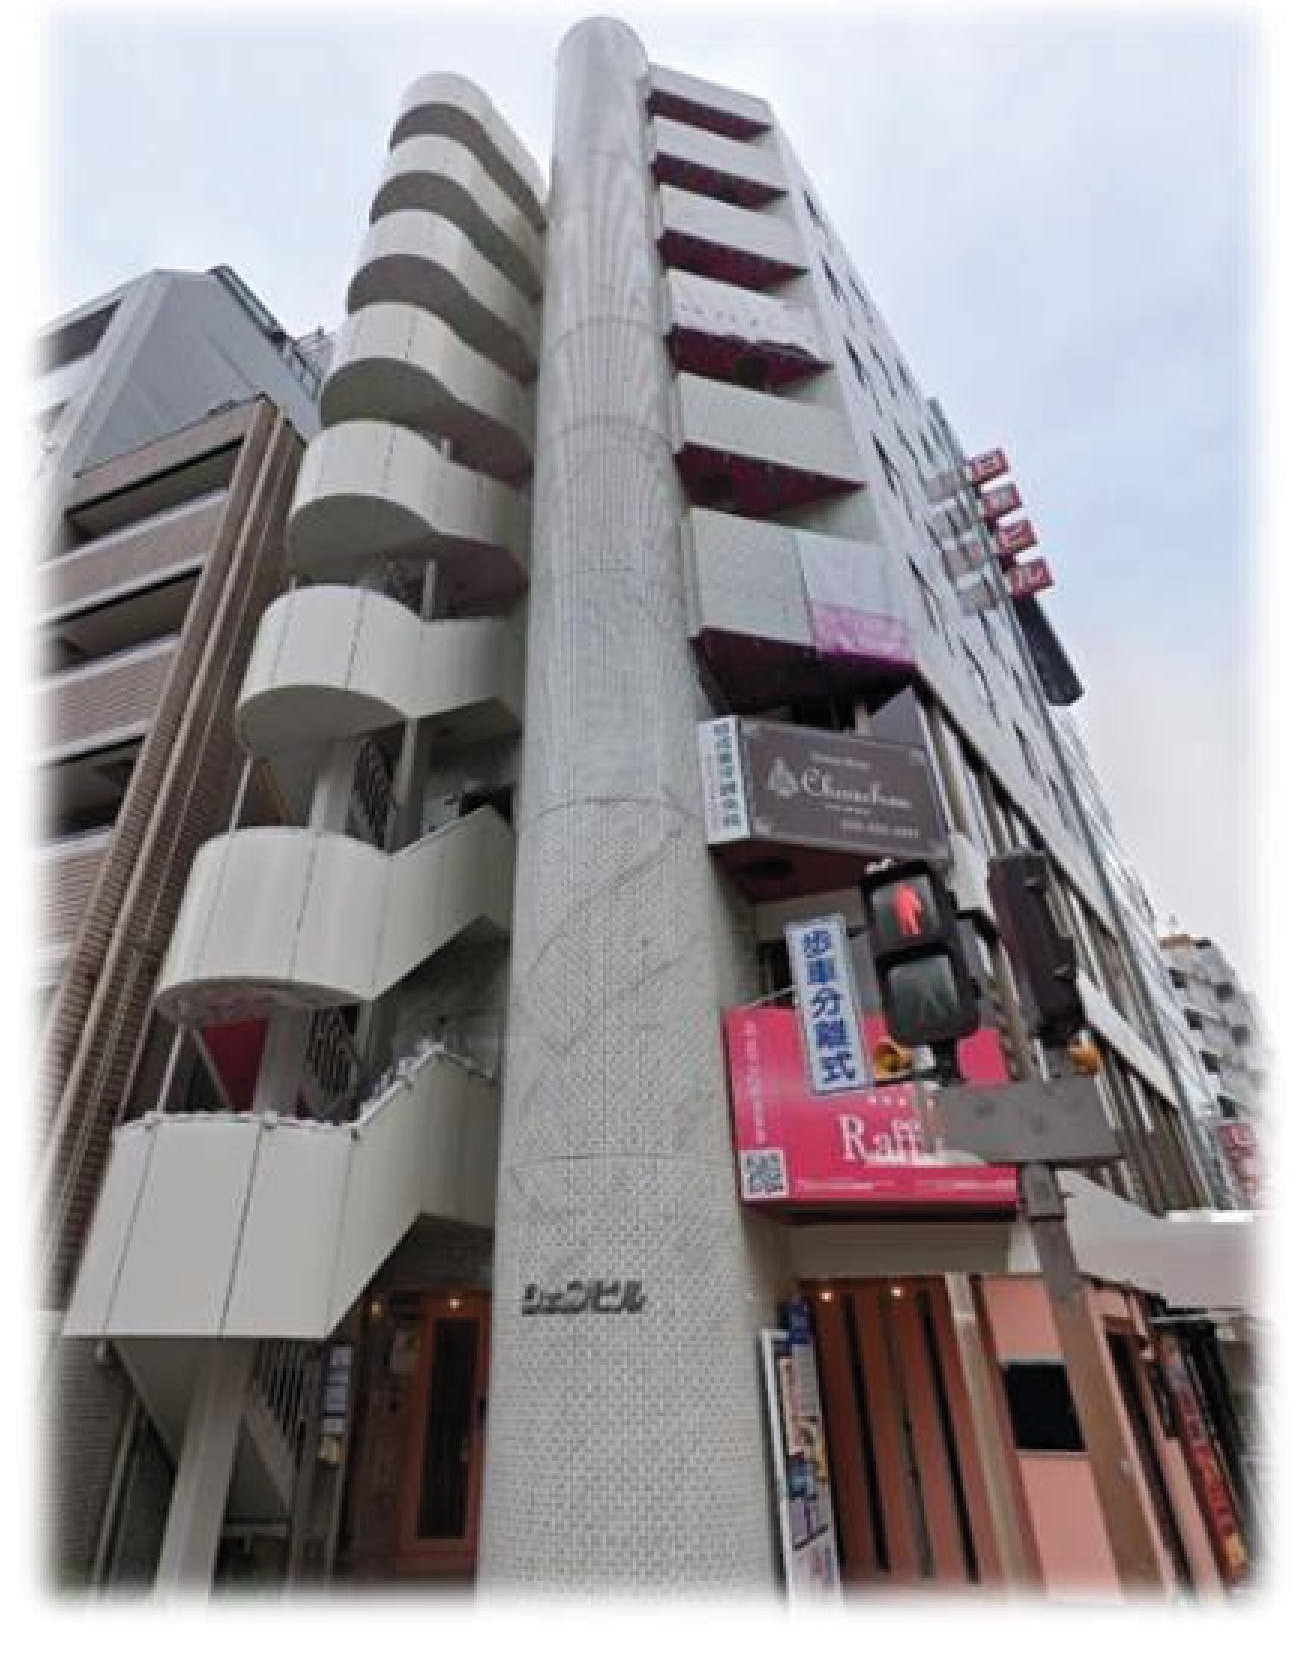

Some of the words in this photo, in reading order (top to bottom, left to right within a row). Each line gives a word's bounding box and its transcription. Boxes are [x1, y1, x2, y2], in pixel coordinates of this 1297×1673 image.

[802, 928, 856, 1084] 歩車分離式
